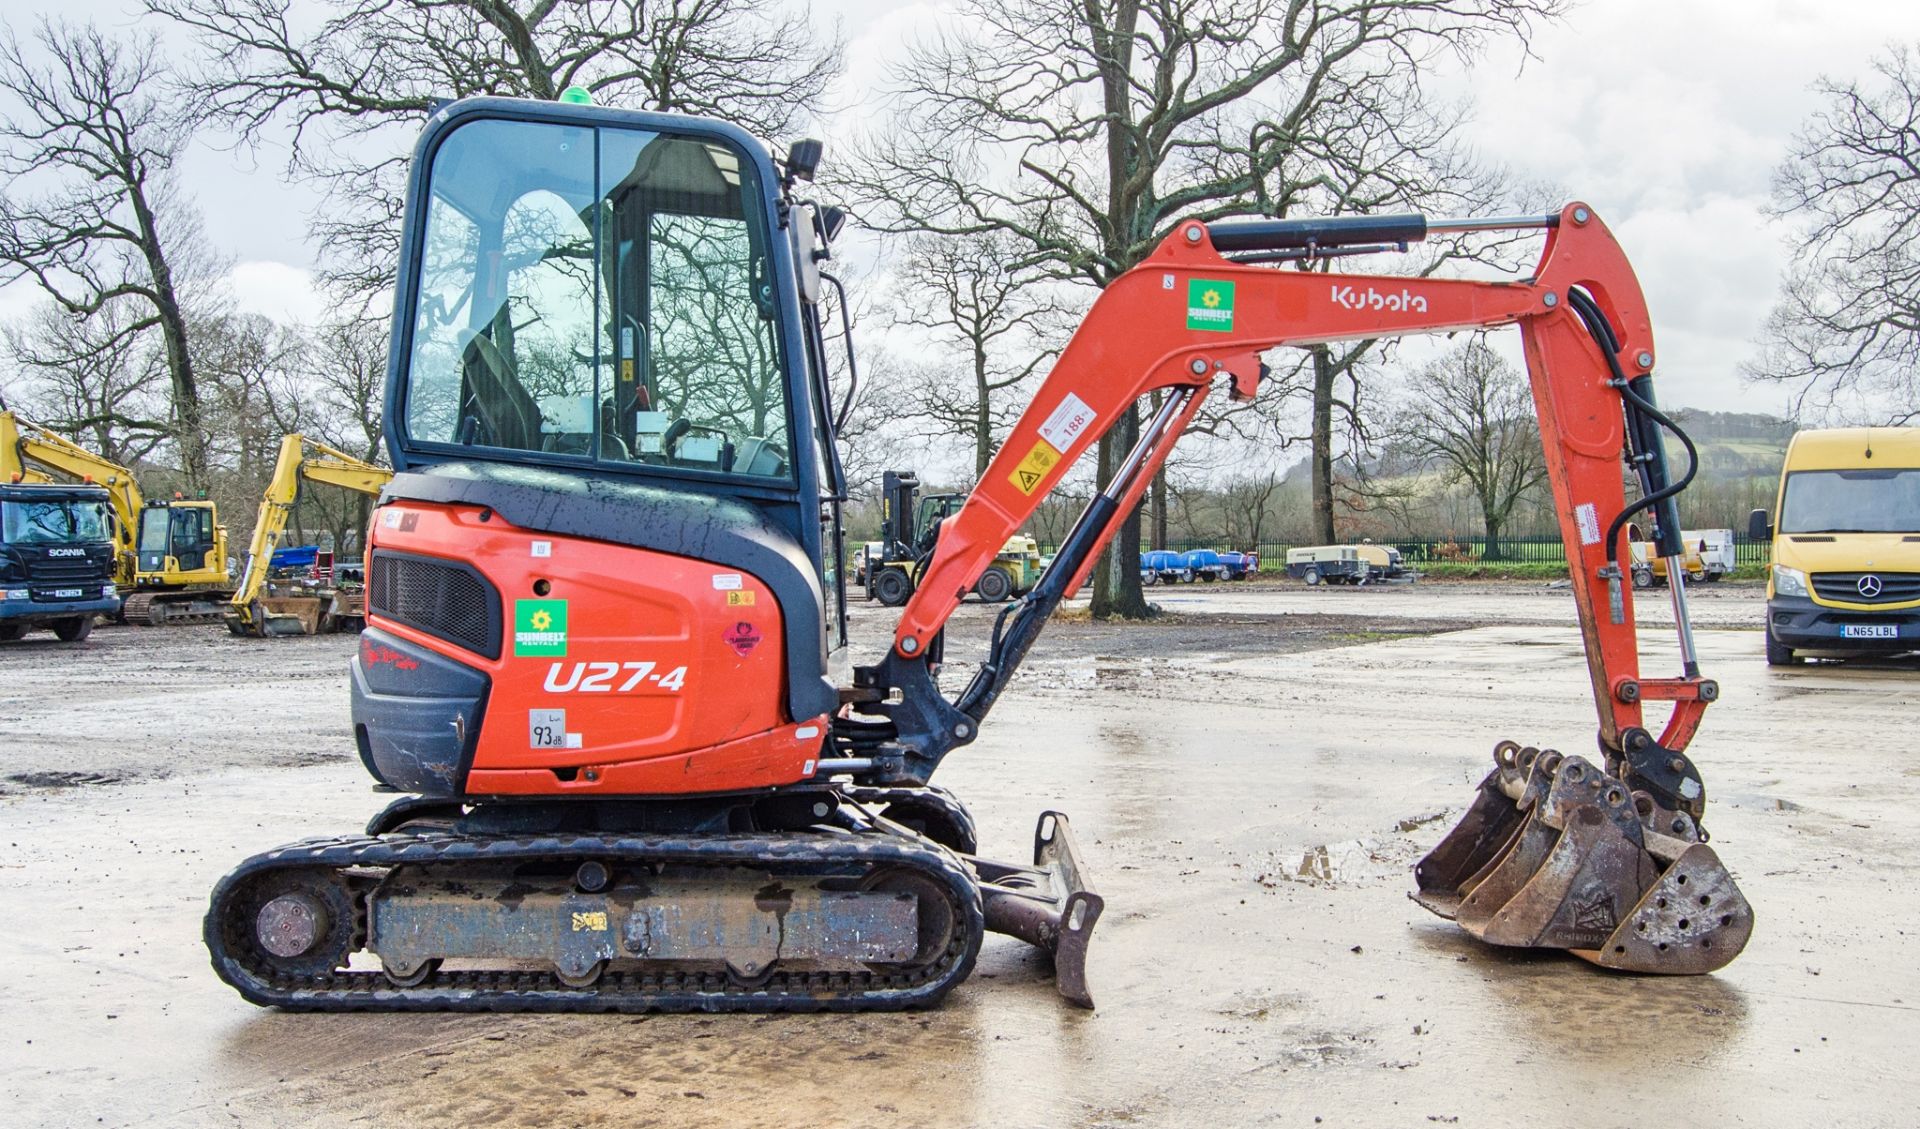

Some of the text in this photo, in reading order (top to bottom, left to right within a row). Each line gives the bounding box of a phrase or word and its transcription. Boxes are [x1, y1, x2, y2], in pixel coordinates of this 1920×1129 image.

[1331, 285, 1427, 313] Kubota
[1188, 307, 1233, 319] SUNBELT
[1063, 414, 1085, 437] 188
[48, 548, 86, 557] SCANIA
[515, 631, 566, 642] SUNBELT
[1846, 626, 1896, 637] LN65 LBL
[543, 661, 688, 693] U27-4
